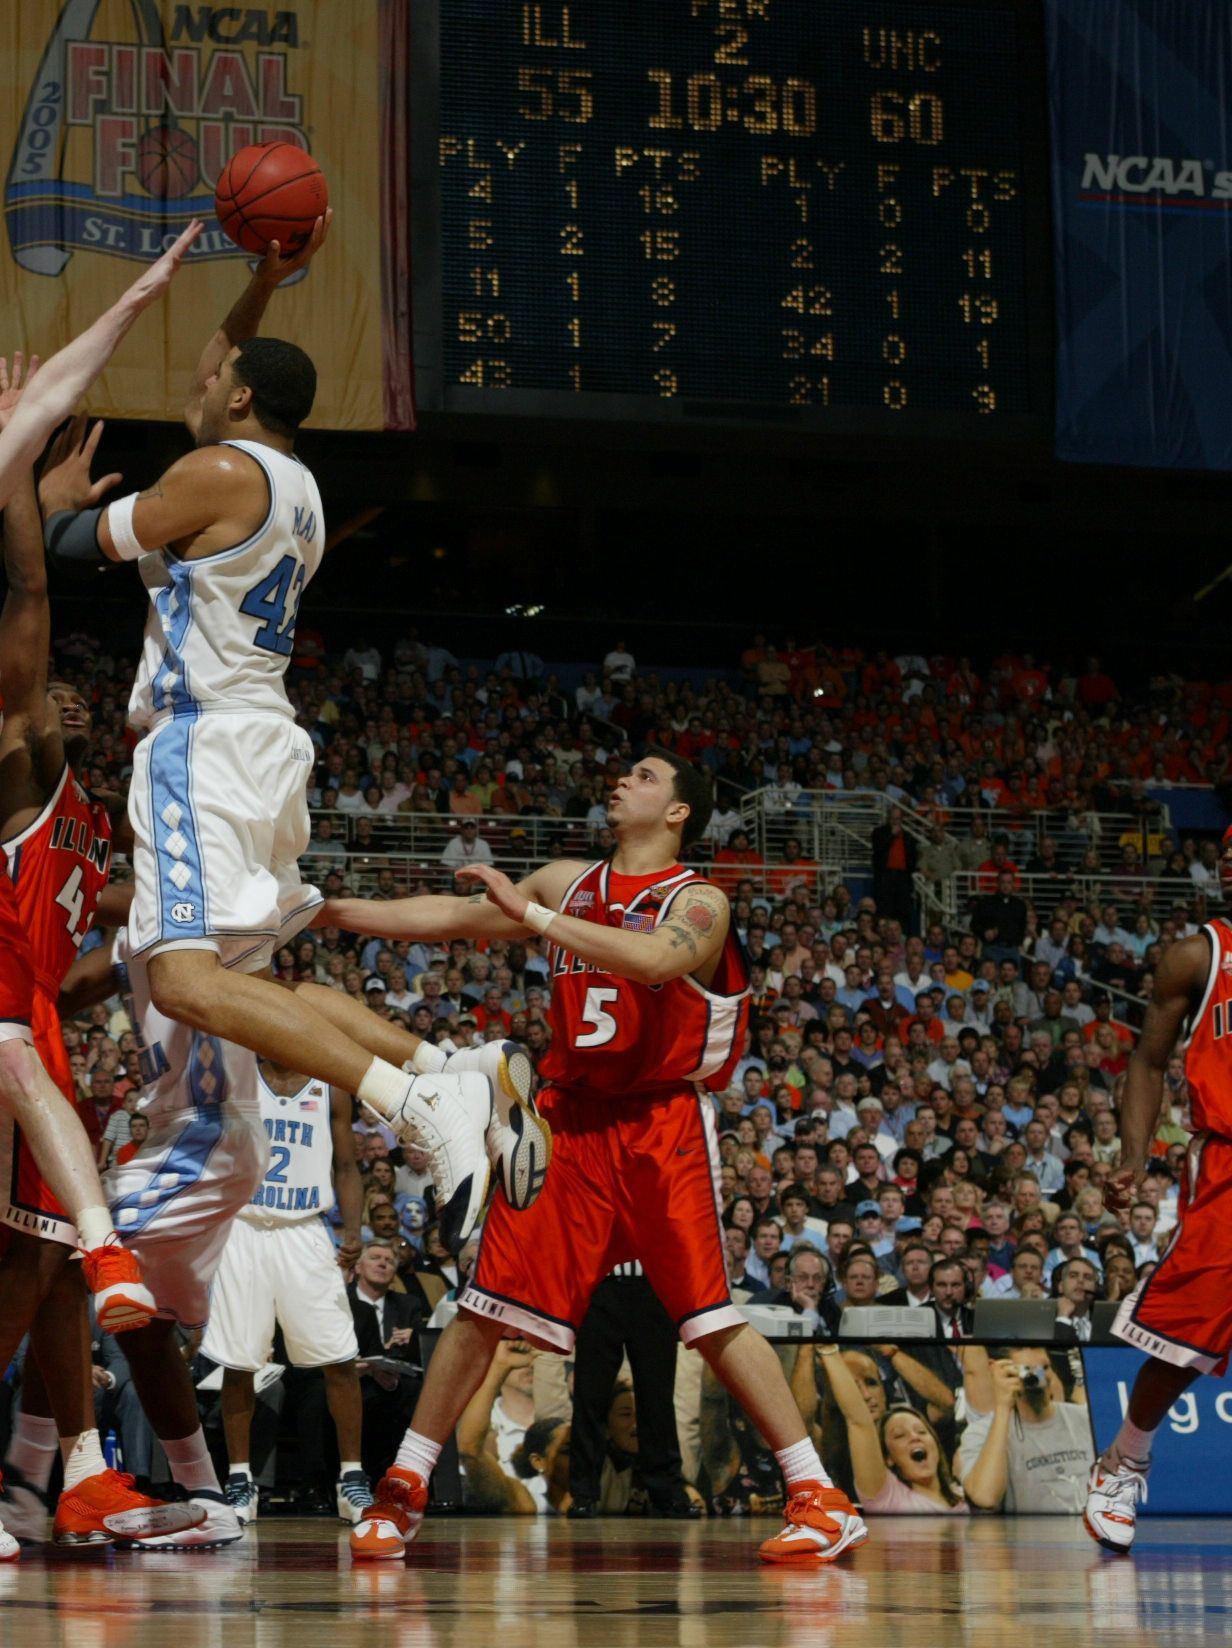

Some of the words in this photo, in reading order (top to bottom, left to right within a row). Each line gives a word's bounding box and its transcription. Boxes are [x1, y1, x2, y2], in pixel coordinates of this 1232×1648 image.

[171, 5, 299, 48] NCAA
[523, 5, 586, 48] ILL
[714, 24, 749, 65] 2
[863, 27, 941, 72] UNC
[67, 41, 302, 126] FINAL
[518, 68, 592, 123] 55
[648, 68, 816, 137] 10:30
[871, 91, 943, 145] 60
[21, 81, 62, 174] 2005
[439, 135, 525, 169] PLY
[559, 143, 582, 173] F
[615, 146, 701, 181] PTS
[1081, 153, 1205, 196] NCAA
[468, 174, 492, 203] 4
[565, 180, 577, 208] 1
[638, 184, 679, 214] 16
[761, 157, 845, 190] PLY
[877, 163, 900, 192] F
[932, 167, 1016, 200] PTS
[82, 217, 126, 248] ST.
[795, 194, 807, 222] 1
[879, 198, 901, 228] 0
[966, 203, 989, 232] 0
[468, 220, 493, 249] 5
[560, 224, 584, 255] 2
[639, 230, 680, 260] 15
[790, 239, 814, 268] 2
[879, 244, 903, 273] 2
[962, 249, 991, 278] 11
[470, 267, 499, 296] 11
[566, 272, 579, 301] 1
[652, 277, 675, 306] 8
[781, 286, 832, 315] 42
[887, 290, 899, 319] 1
[958, 293, 998, 324] 19
[458, 312, 511, 342] 50
[568, 318, 580, 347] 1
[652, 322, 676, 351] 7
[781, 330, 833, 360] 34
[882, 335, 905, 364] 0
[977, 339, 989, 369] 1
[459, 358, 512, 388] 43
[568, 365, 581, 392] 1
[653, 368, 677, 397] 9
[789, 376, 829, 405] 21
[883, 381, 907, 410] 0
[972, 385, 995, 413] 9
[575, 987, 618, 1048] 5
[263, 1118, 314, 1148] ORTH
[265, 1146, 291, 1184] 2
[248, 1184, 320, 1211] ROLINA
[6, 1207, 58, 1234] ILLINI
[1122, 1322, 1166, 1355] ILLINI
